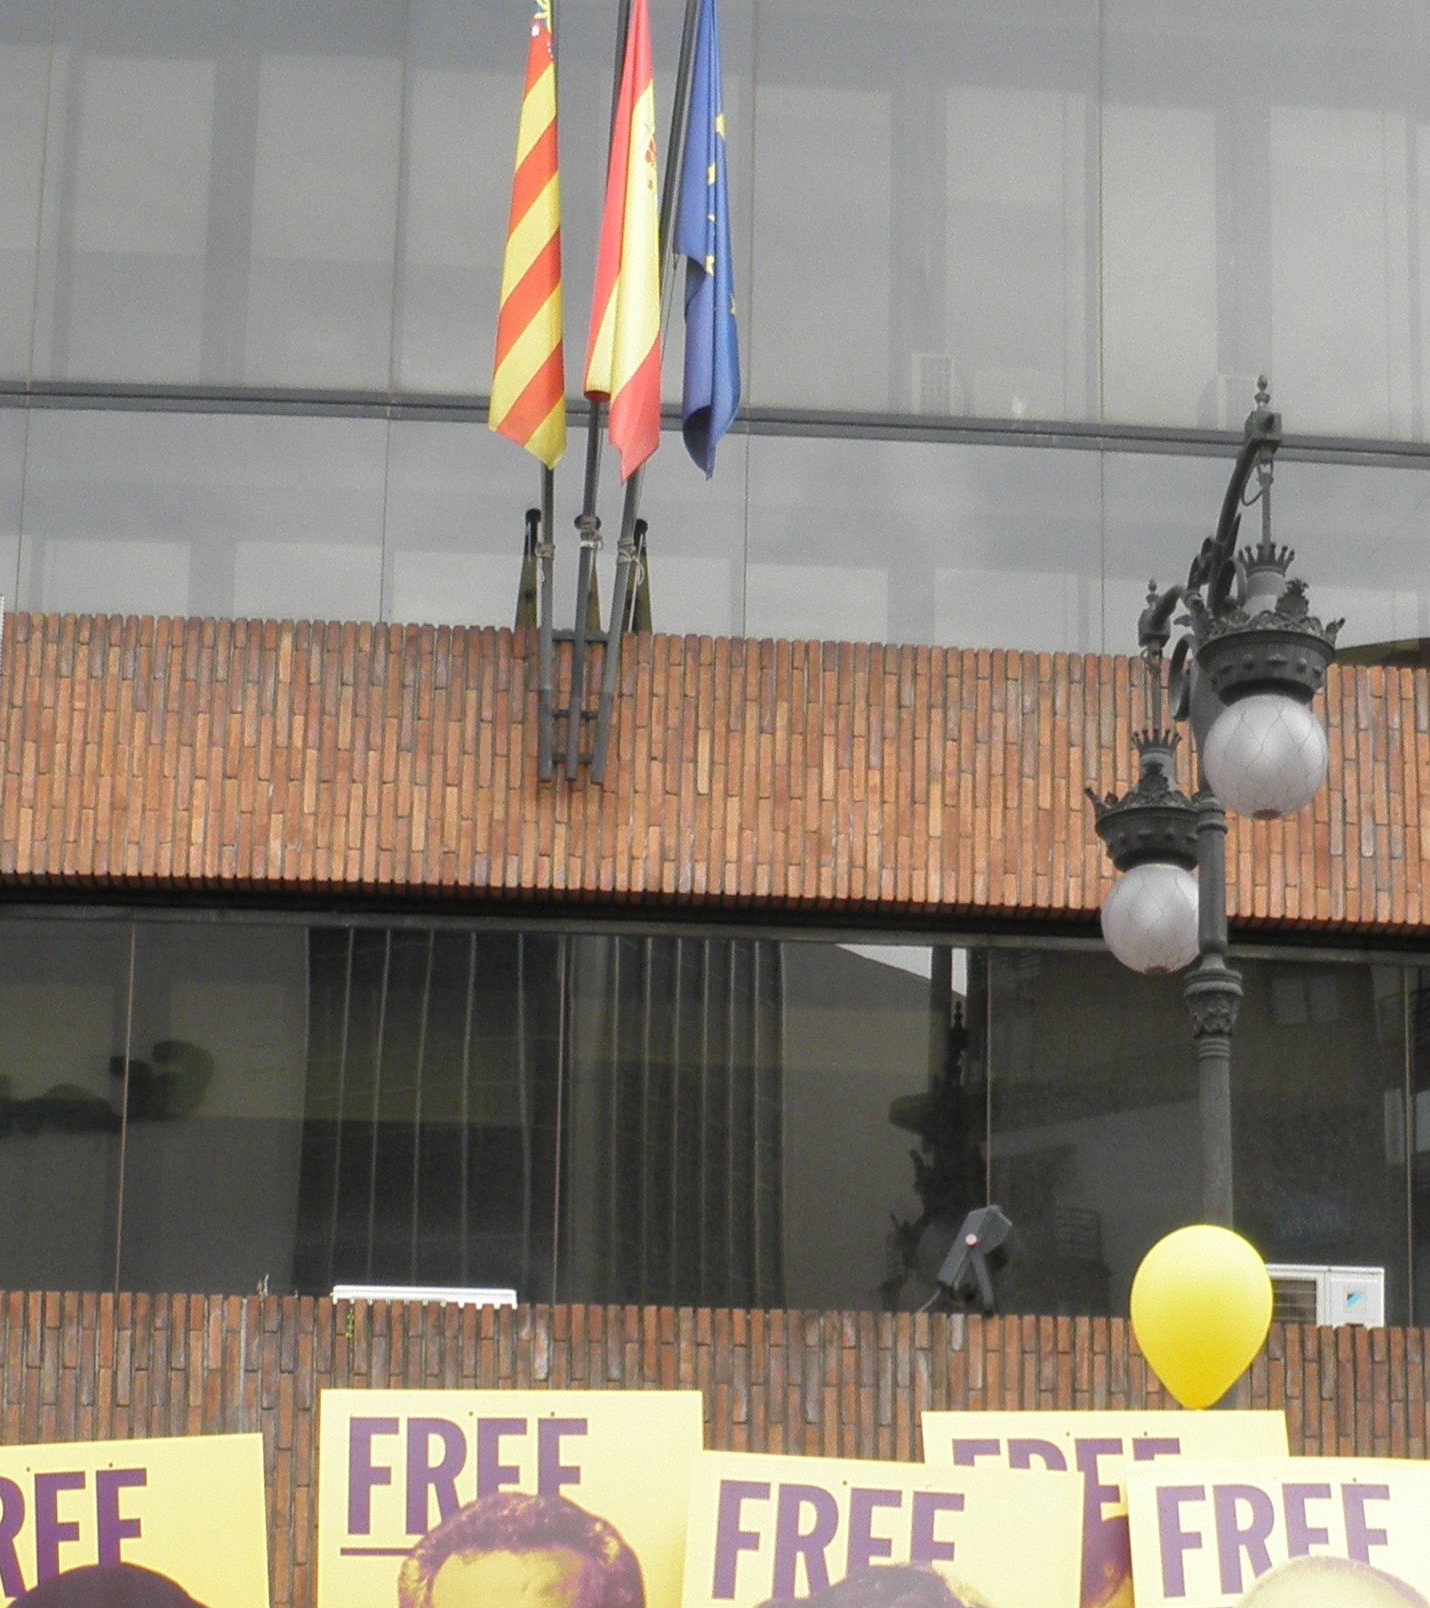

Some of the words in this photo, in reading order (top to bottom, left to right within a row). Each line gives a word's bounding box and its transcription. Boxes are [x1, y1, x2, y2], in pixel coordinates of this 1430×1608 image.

[347, 1416, 587, 1536] FREE
[713, 1479, 964, 1600] FREE
[1156, 1484, 1390, 1599] FREE
